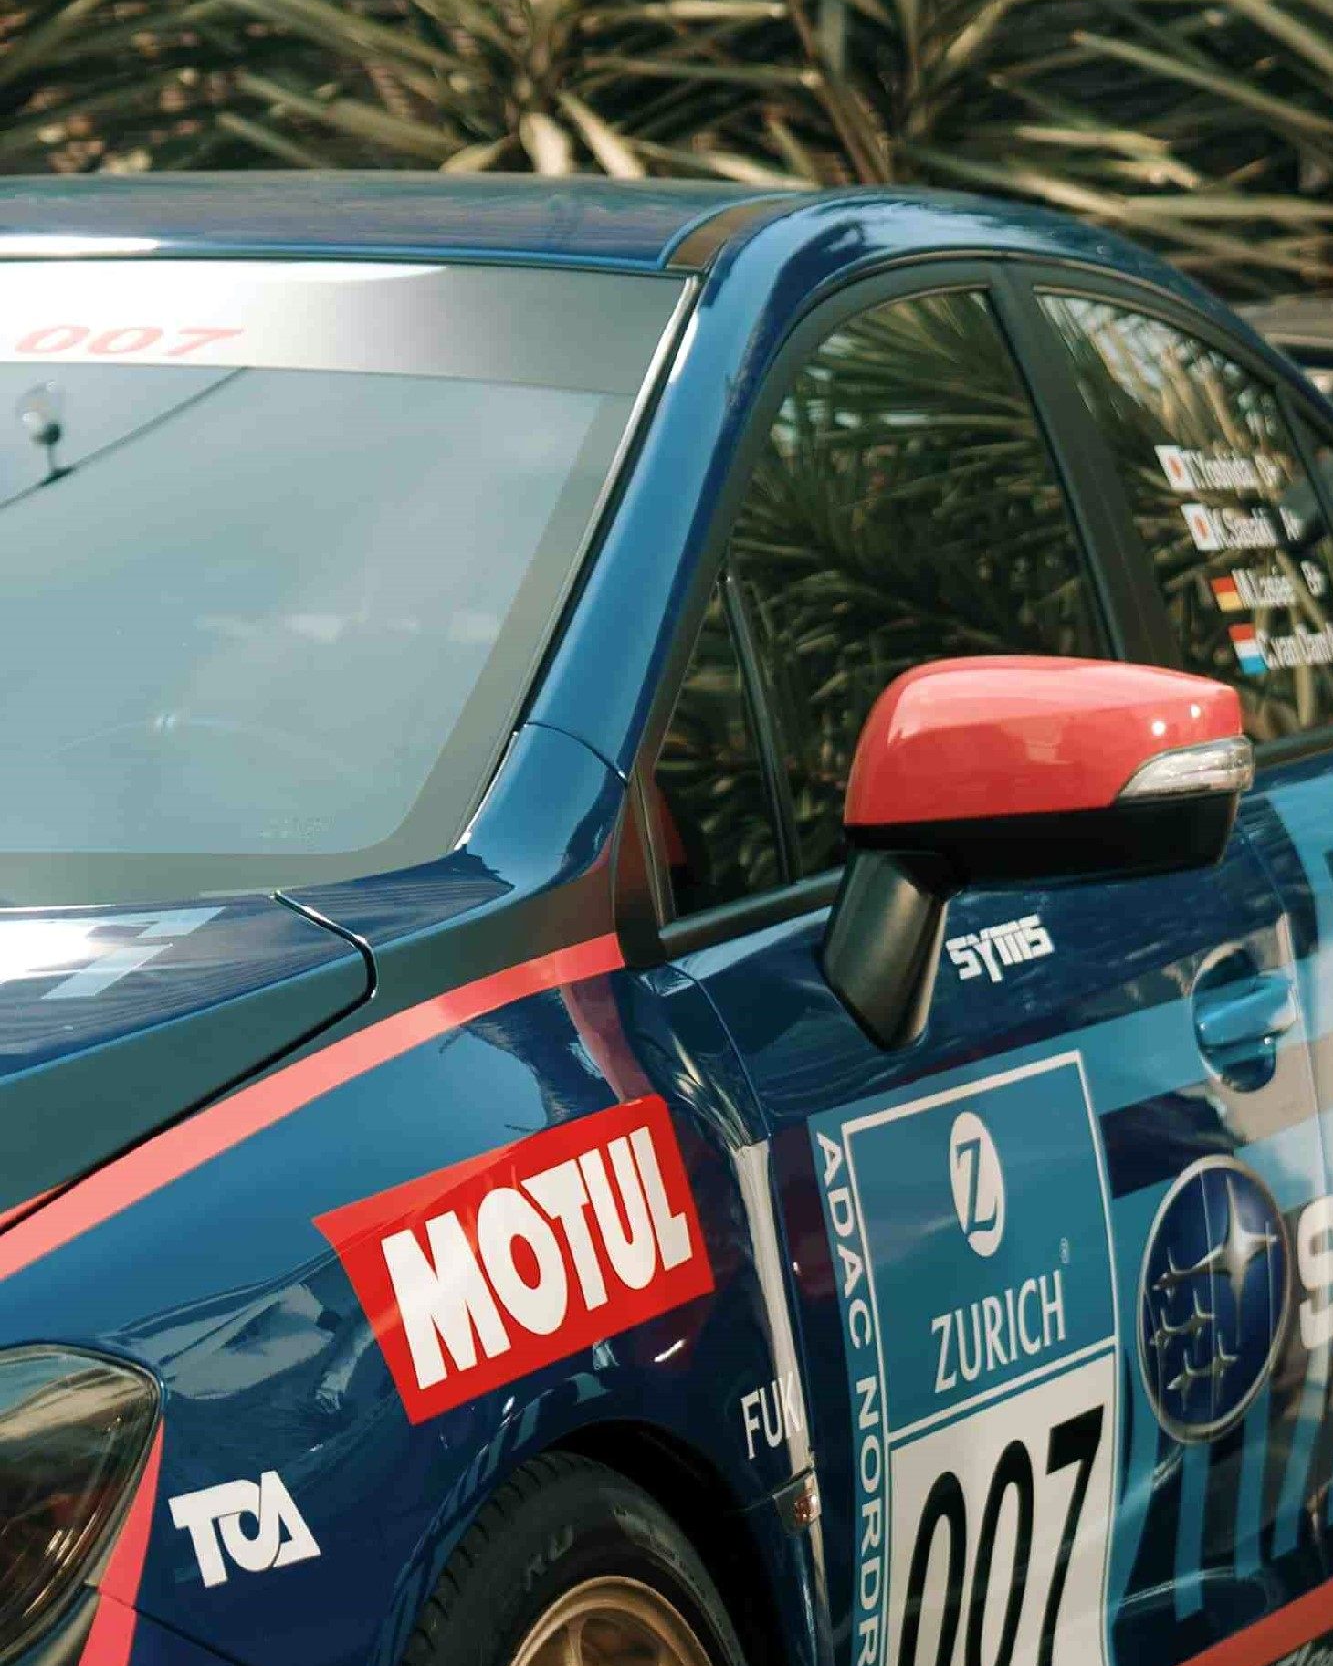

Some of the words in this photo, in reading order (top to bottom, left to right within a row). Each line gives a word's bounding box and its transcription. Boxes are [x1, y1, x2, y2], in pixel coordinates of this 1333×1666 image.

[15, 324, 245, 357] 007
[380, 1124, 693, 1391] MOTUL
[816, 1131, 872, 1350] ADAC
[931, 1268, 1067, 1395] ZURICH
[168, 1469, 322, 1589] TOA
